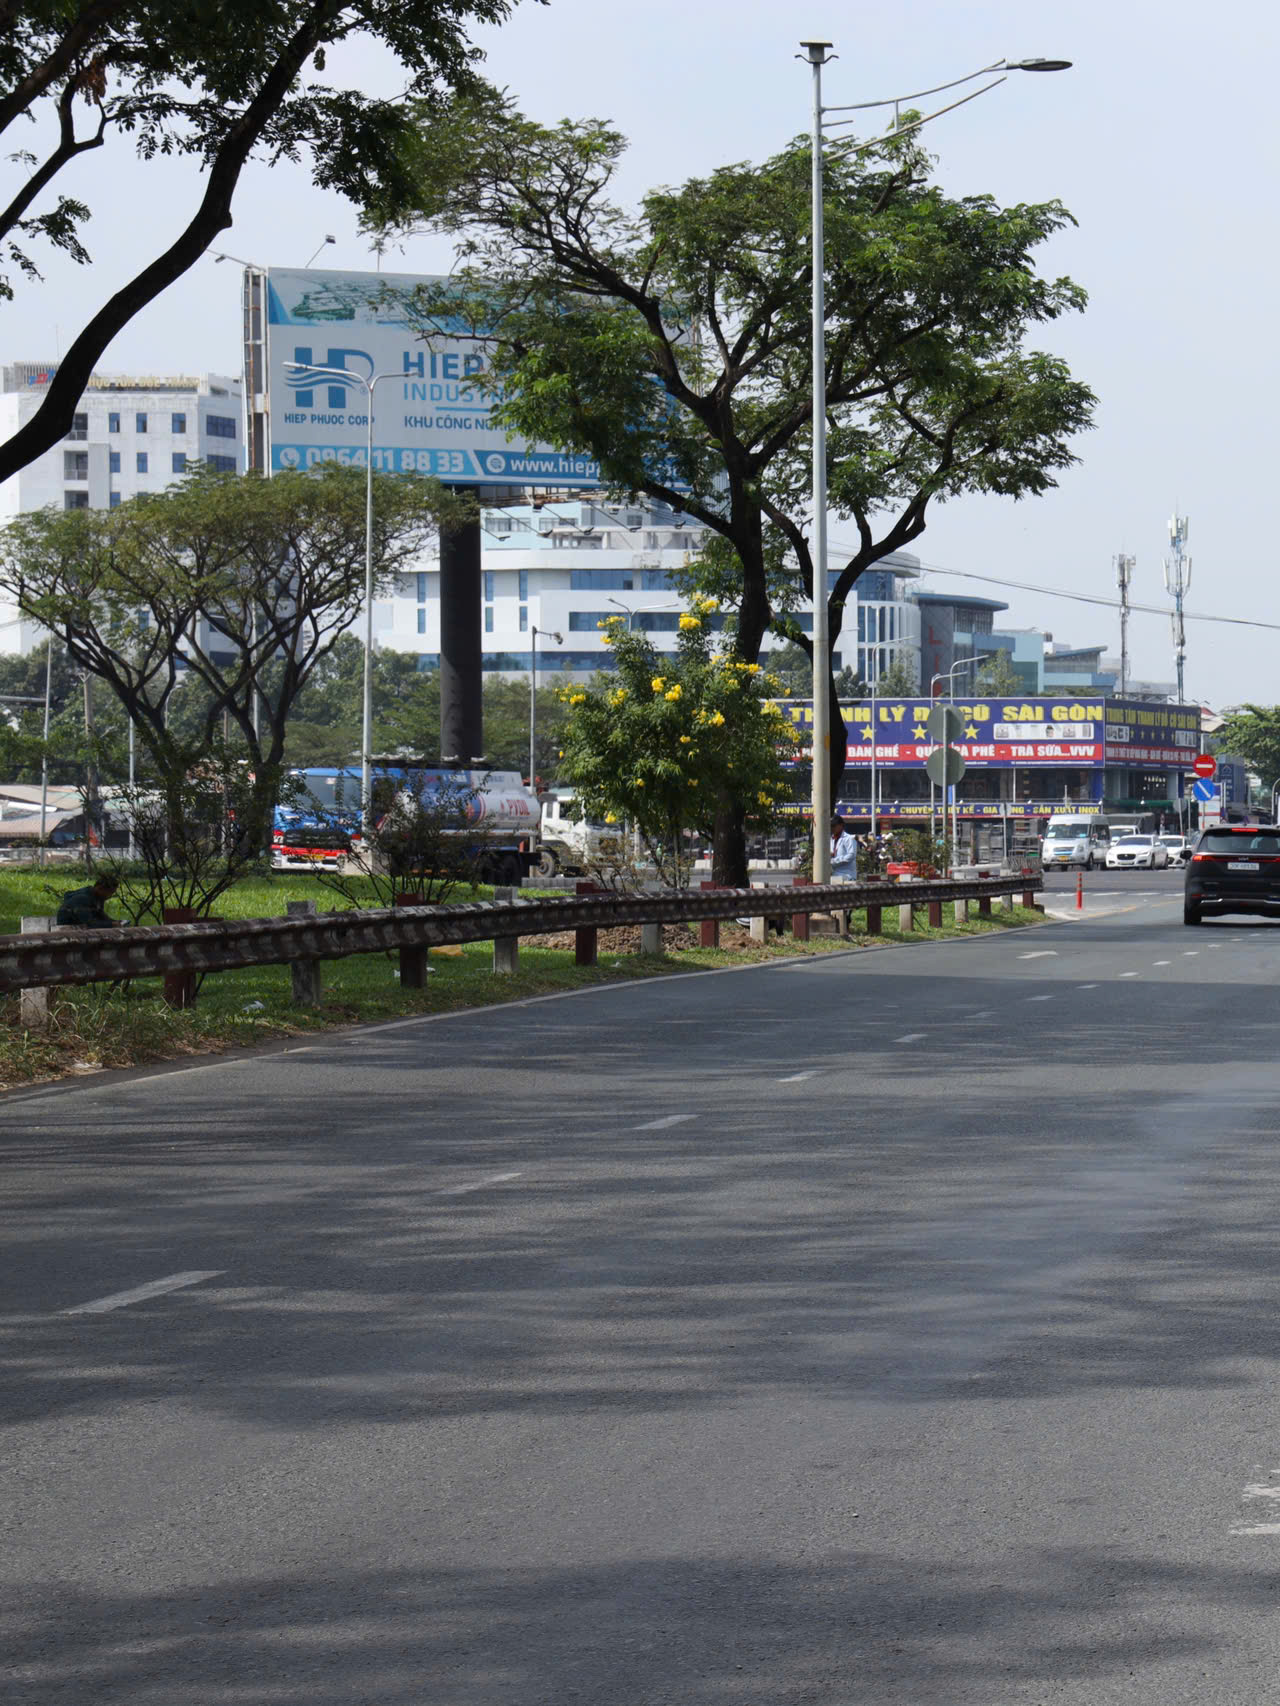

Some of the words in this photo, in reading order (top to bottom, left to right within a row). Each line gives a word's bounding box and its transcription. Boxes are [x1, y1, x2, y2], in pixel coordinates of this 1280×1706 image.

[403, 351, 484, 380] HIEP
[284, 412, 307, 424] HIEP
[311, 413, 345, 425] PHUOC
[404, 415, 433, 429] KHU
[435, 414, 472, 430] CÔNG
[306, 447, 368, 468] 0964
[373, 449, 395, 471] 11
[401, 449, 431, 471] 88
[438, 450, 464, 473] 33
[788, 707, 871, 723] THNH
[879, 704, 907, 723] LÝ
[1002, 704, 1045, 721] SÀI
[1051, 704, 1103, 721] GÒN
[875, 743, 900, 758] GHẾ
[971, 743, 996, 757] PHÊ
[1010, 745, 1035, 757] TRÀ
[1078, 806, 1100, 814] INOX
